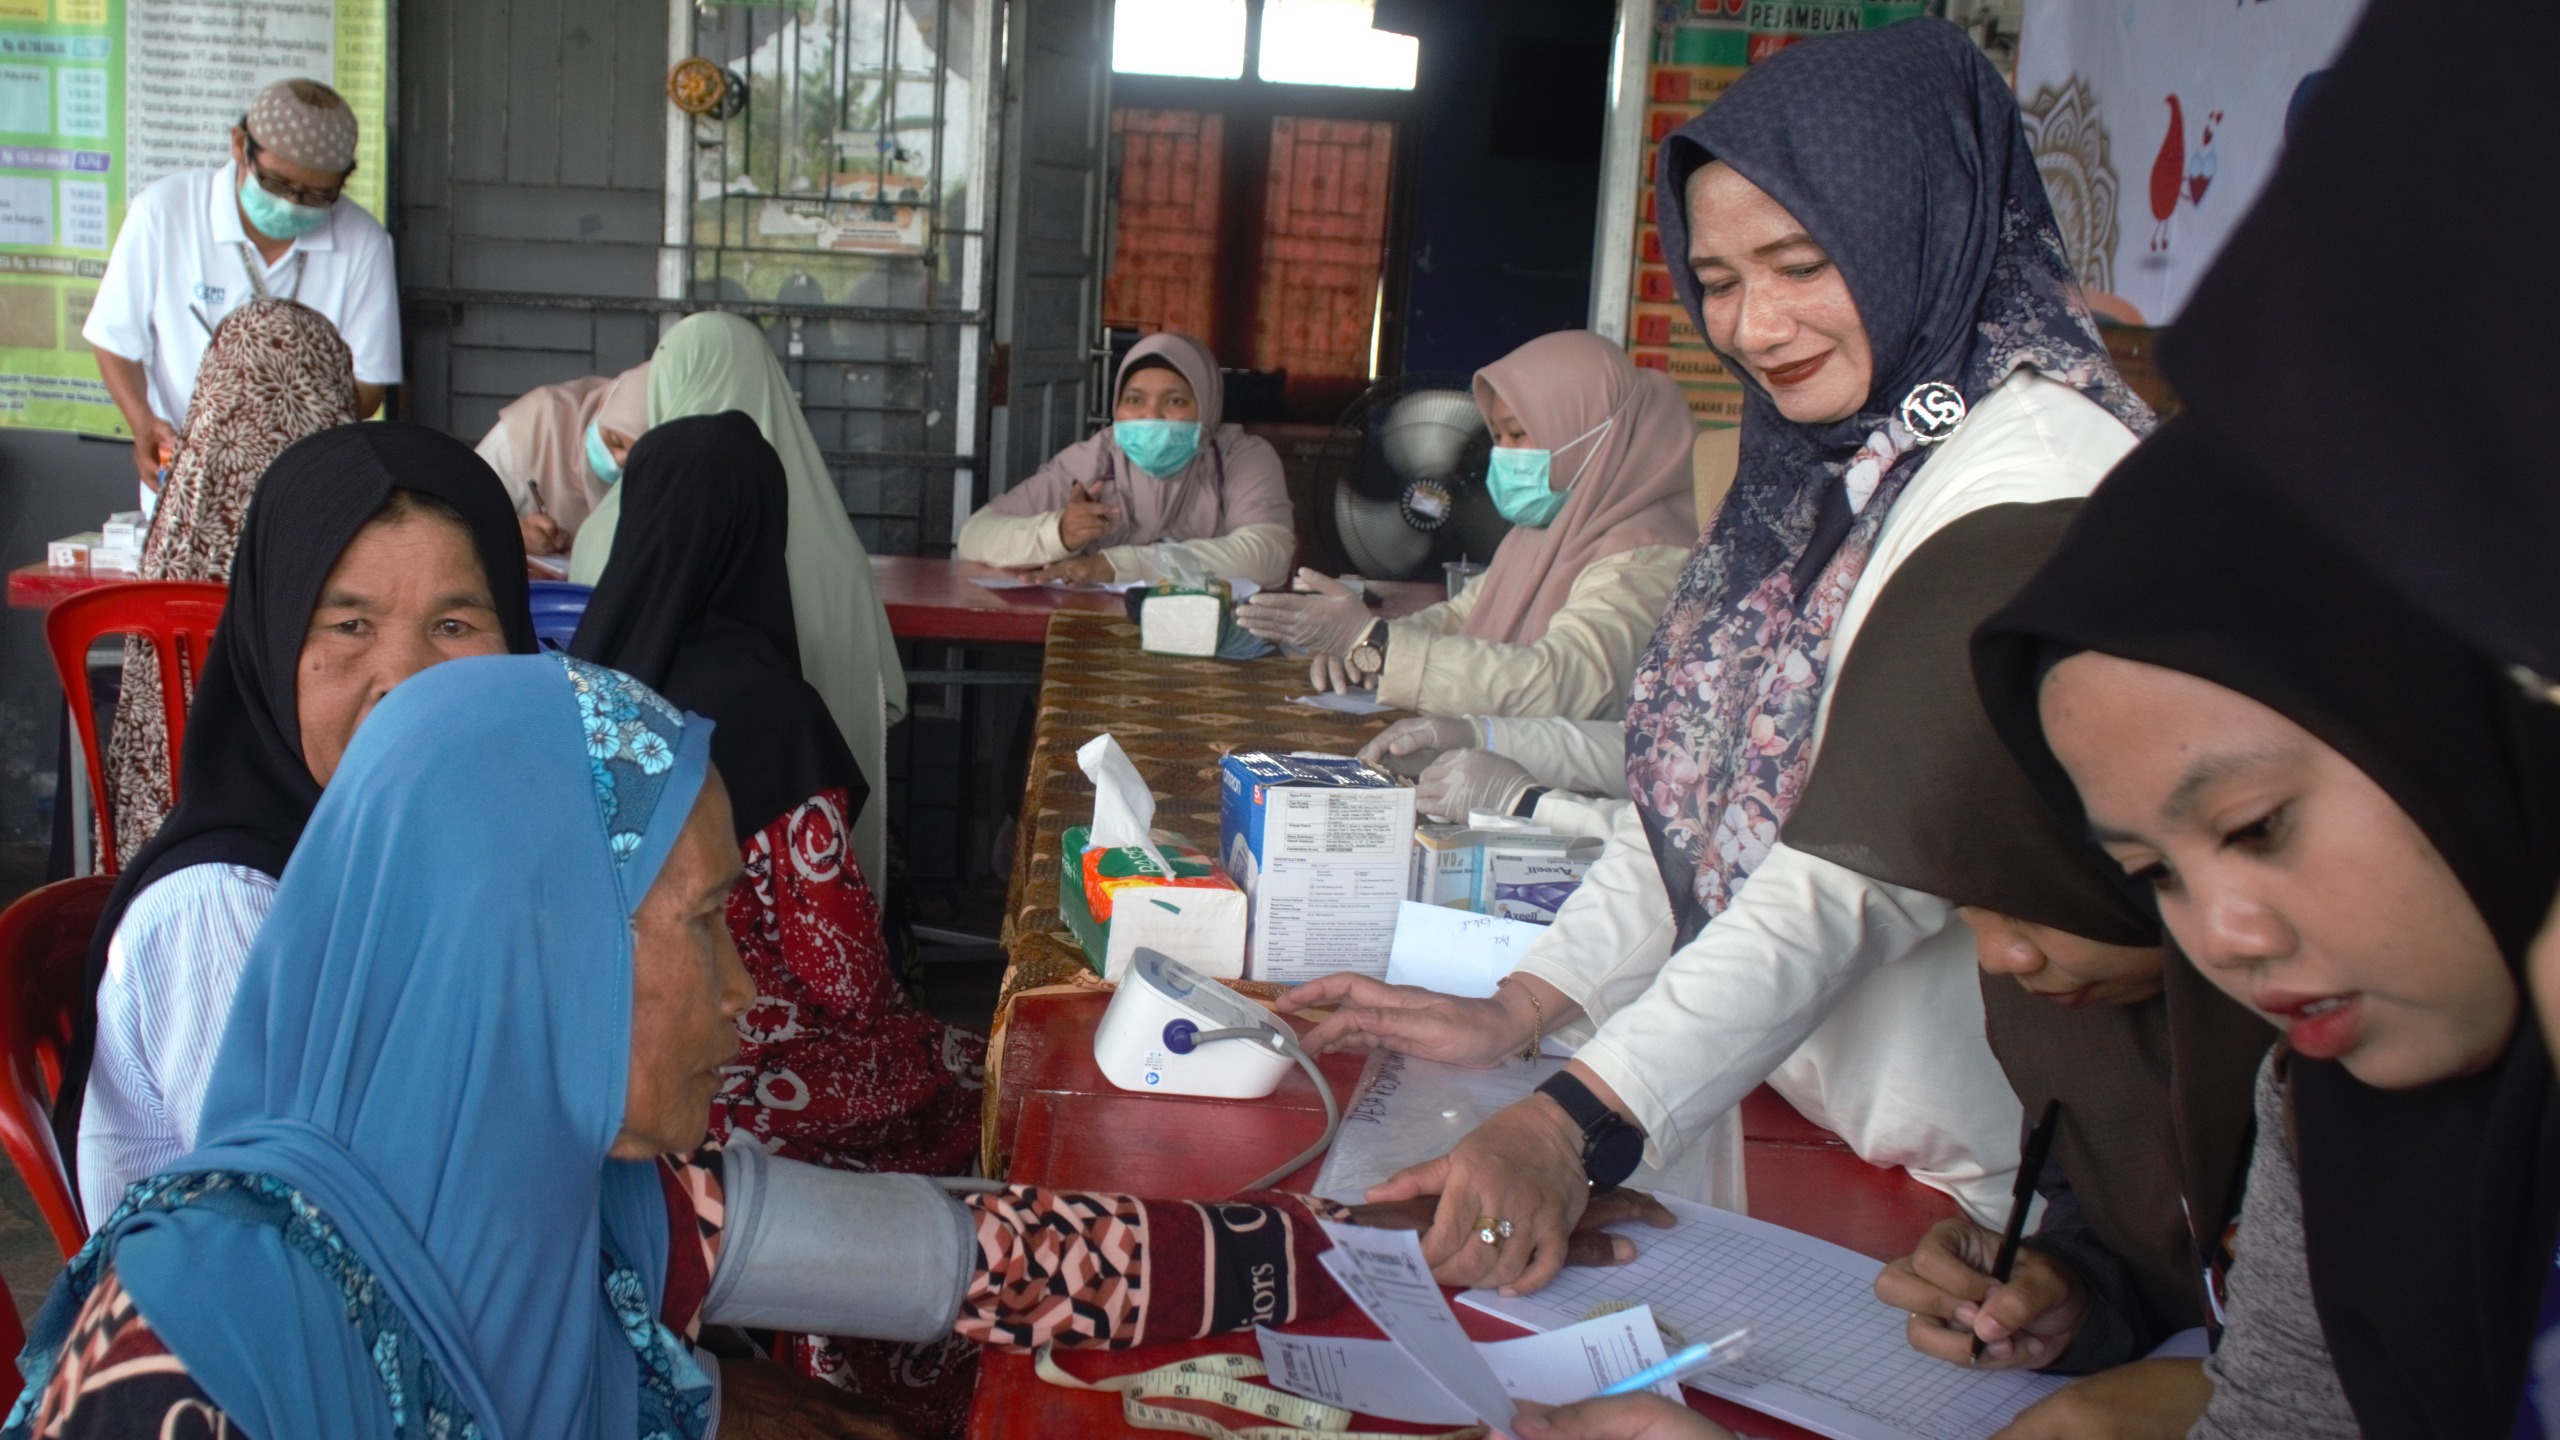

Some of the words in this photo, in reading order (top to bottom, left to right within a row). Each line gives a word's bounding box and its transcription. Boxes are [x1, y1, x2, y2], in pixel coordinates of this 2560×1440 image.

[1751, 5, 1861, 32] PEJAMBUAN
[1347, 1096, 1386, 1124] DESA
[1174, 1385, 1190, 1397] 51
[1222, 1392, 1237, 1406] 52
[1264, 1404, 1279, 1418] 53
[1303, 1414, 1321, 1431] 54
